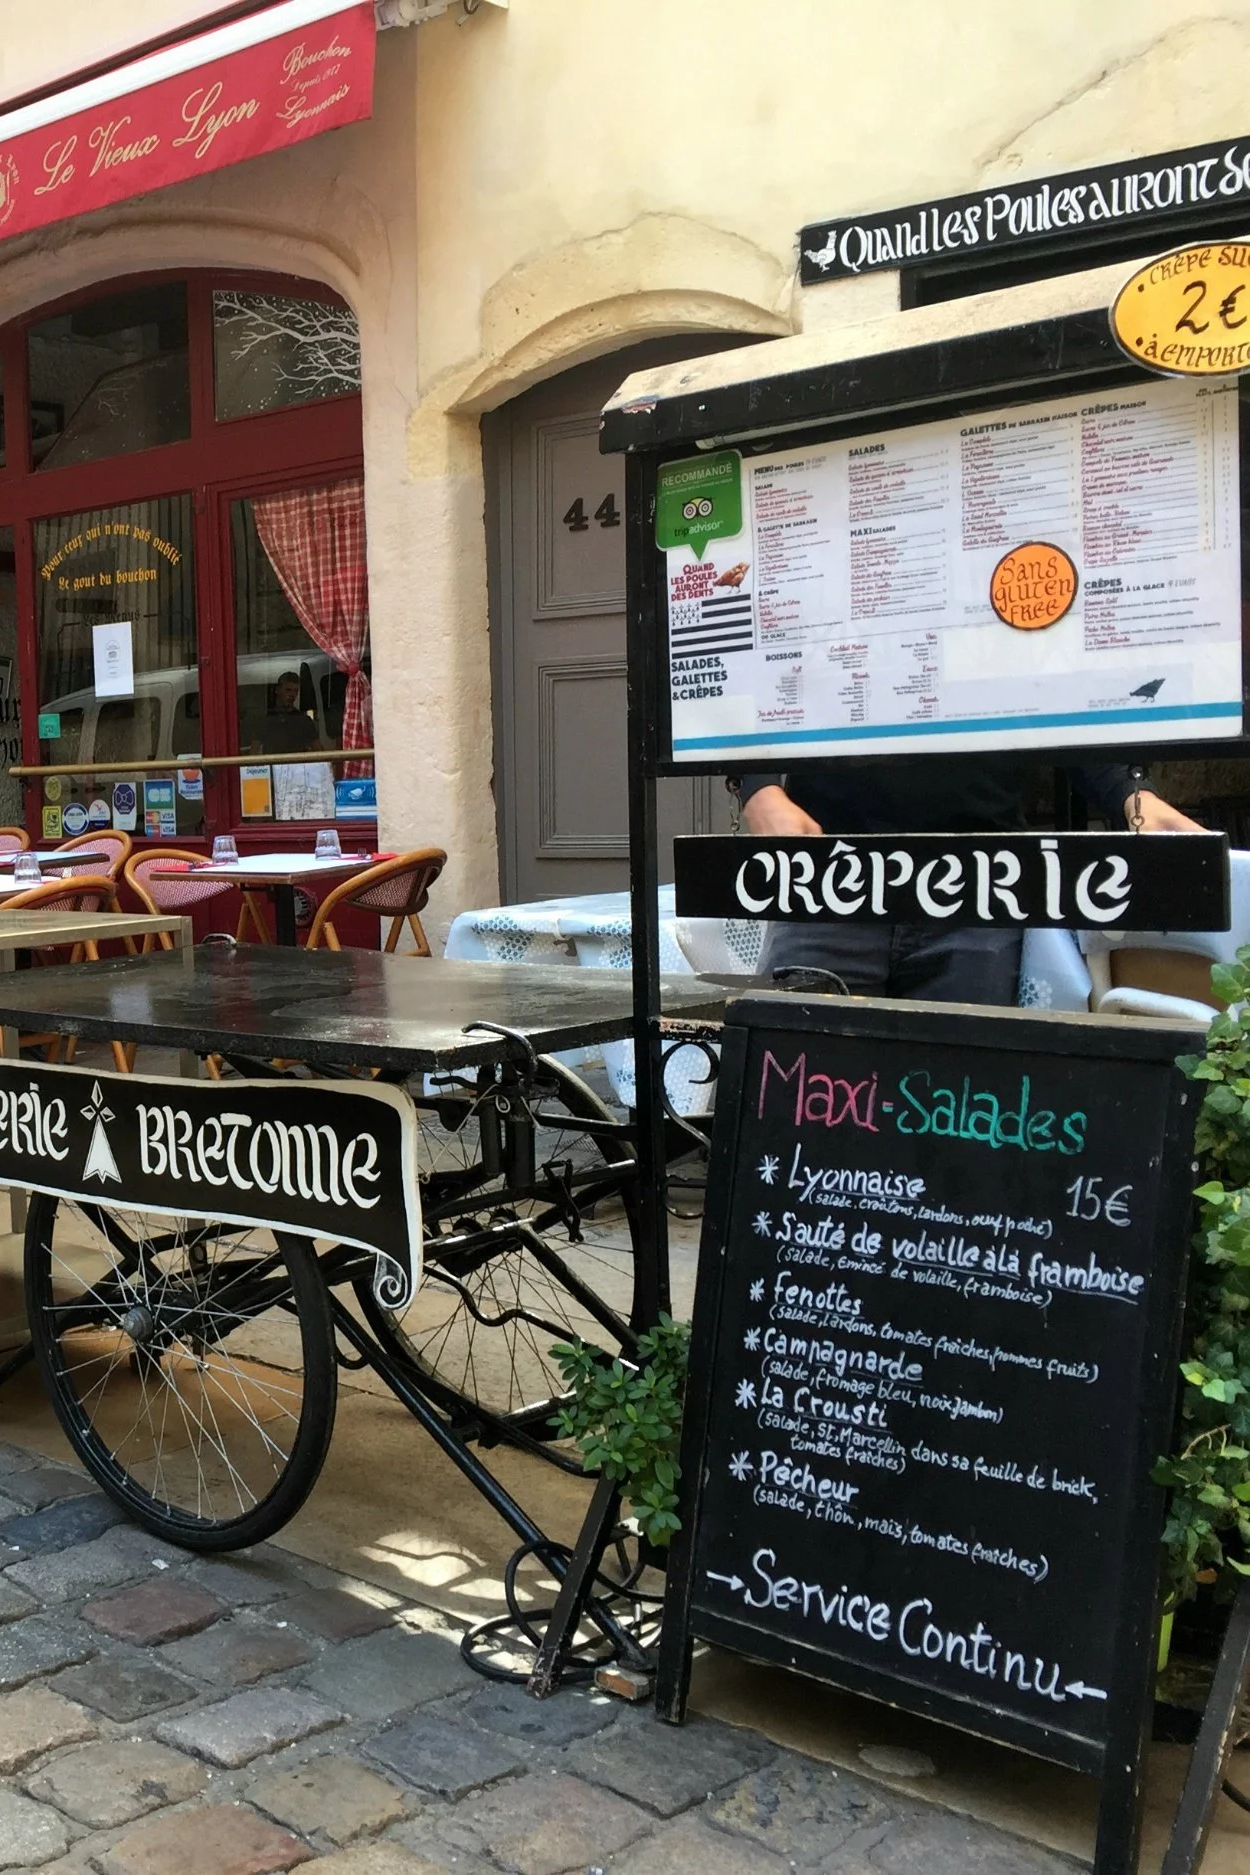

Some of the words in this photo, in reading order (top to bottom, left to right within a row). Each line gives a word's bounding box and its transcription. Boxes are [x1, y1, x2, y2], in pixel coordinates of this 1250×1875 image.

[279, 35, 351, 85] Bouchon
[276, 84, 350, 128] Lyonnais
[34, 135, 77, 196] Le
[88, 115, 160, 177] Vieux
[172, 81, 260, 159] Lyon
[1081, 402, 1119, 417] CRÊPES
[960, 421, 1007, 437] GALETTES
[849, 444, 886, 457] SALADES
[661, 463, 733, 488] RECOMMANDÉ
[563, 493, 620, 532] 44
[682, 562, 715, 576] QUAND
[685, 571, 718, 582] POULES
[1000, 556, 1058, 586] Sans
[1084, 577, 1123, 590] CRÊPES
[671, 656, 725, 673] SALADES,
[765, 651, 803, 662] BOISSONS
[671, 670, 728, 687] GALETTES
[757, 1049, 1088, 1154] Maxi-Salades
[787, 1143, 927, 1201] Lyonnaise
[775, 1211, 846, 1250] Sauté
[851, 1221, 882, 1255] de
[892, 1229, 980, 1268] volaille
[1027, 1251, 1146, 1296] framboise
[890, 1261, 909, 1281] de
[815, 1367, 876, 1400] fromage
[760, 1376, 784, 1409] La
[793, 1386, 889, 1428] Crousti
[790, 1434, 843, 1458] tomates
[759, 1450, 860, 1503] Pêcheur
[910, 1439, 948, 1467] dans
[973, 1456, 1024, 1482] feuille
[1026, 1464, 1047, 1490] de
[910, 1524, 969, 1556] tomates
[743, 1547, 892, 1642] Service
[898, 1597, 1067, 1702] Continu
